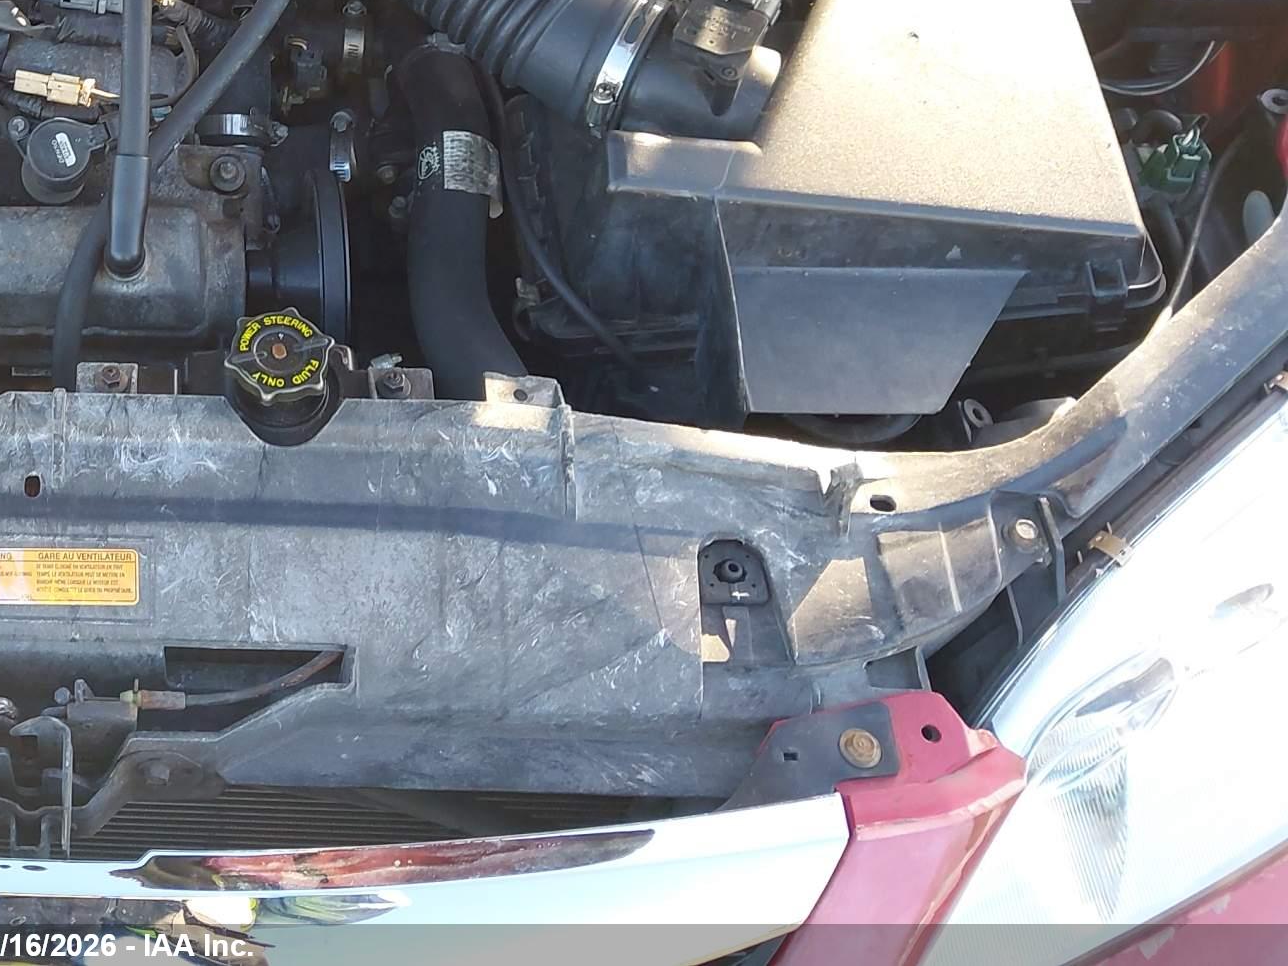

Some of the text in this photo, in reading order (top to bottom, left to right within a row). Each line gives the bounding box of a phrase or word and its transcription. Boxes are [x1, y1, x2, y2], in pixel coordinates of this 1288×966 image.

[239, 315, 313, 351] POWER STEERING
[252, 359, 320, 387] FLUID ONLY
[38, 552, 132, 561] GARE AU VENTILATEUR
